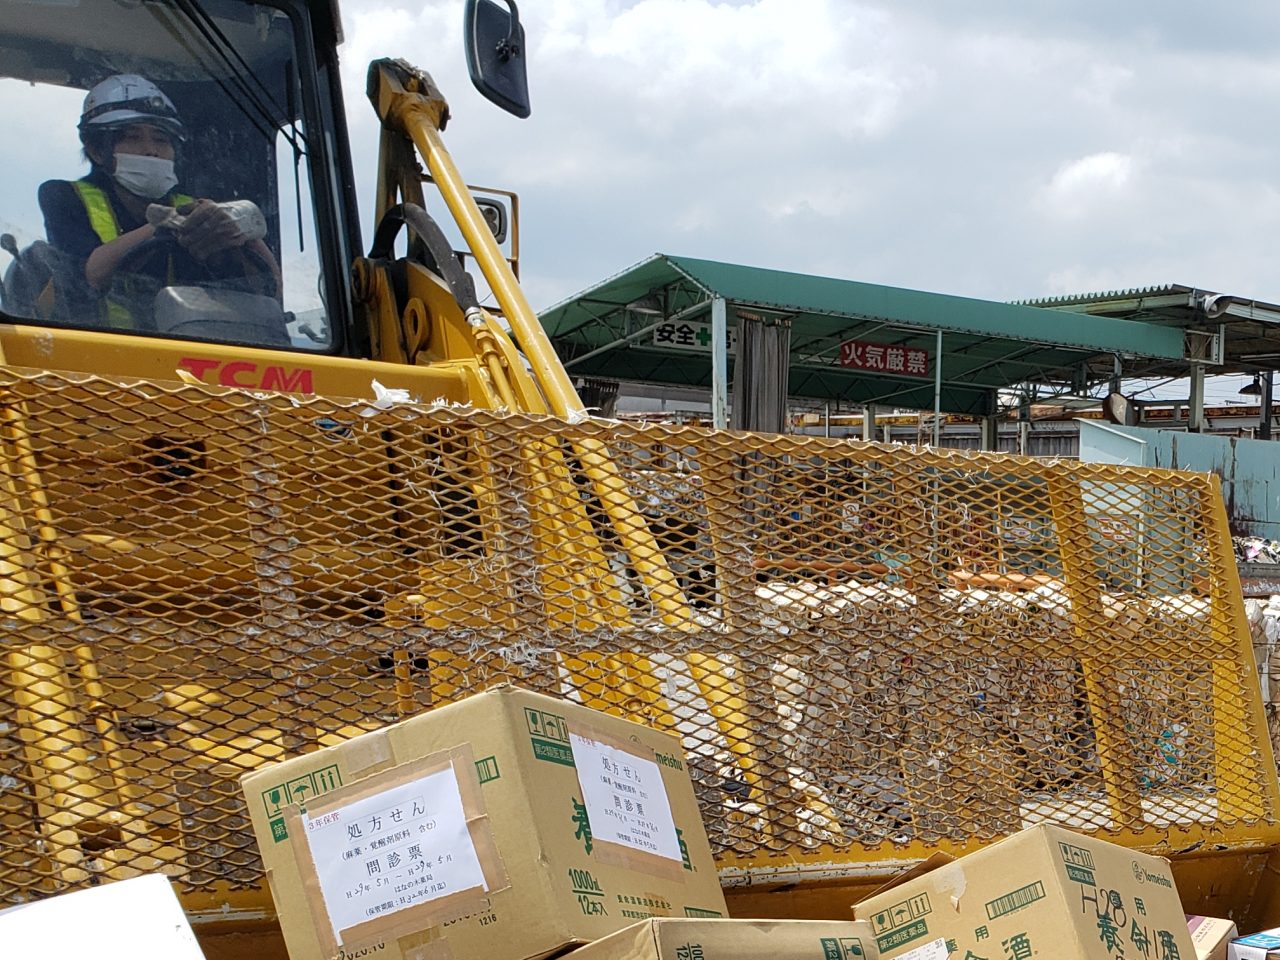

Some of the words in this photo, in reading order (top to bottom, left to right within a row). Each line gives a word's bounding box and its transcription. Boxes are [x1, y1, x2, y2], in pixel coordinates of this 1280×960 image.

[656, 324, 695, 345] 安全
[844, 344, 926, 372] 火気厳禁
[177, 357, 314, 394] TCM
[601, 755, 642, 783] 処方せん
[613, 795, 645, 816] 問診票
[308, 811, 340, 831] 3年保管
[347, 801, 426, 840] 処方せん
[365, 845, 424, 876] 問診票
[878, 923, 926, 951] 第2類医薬品
